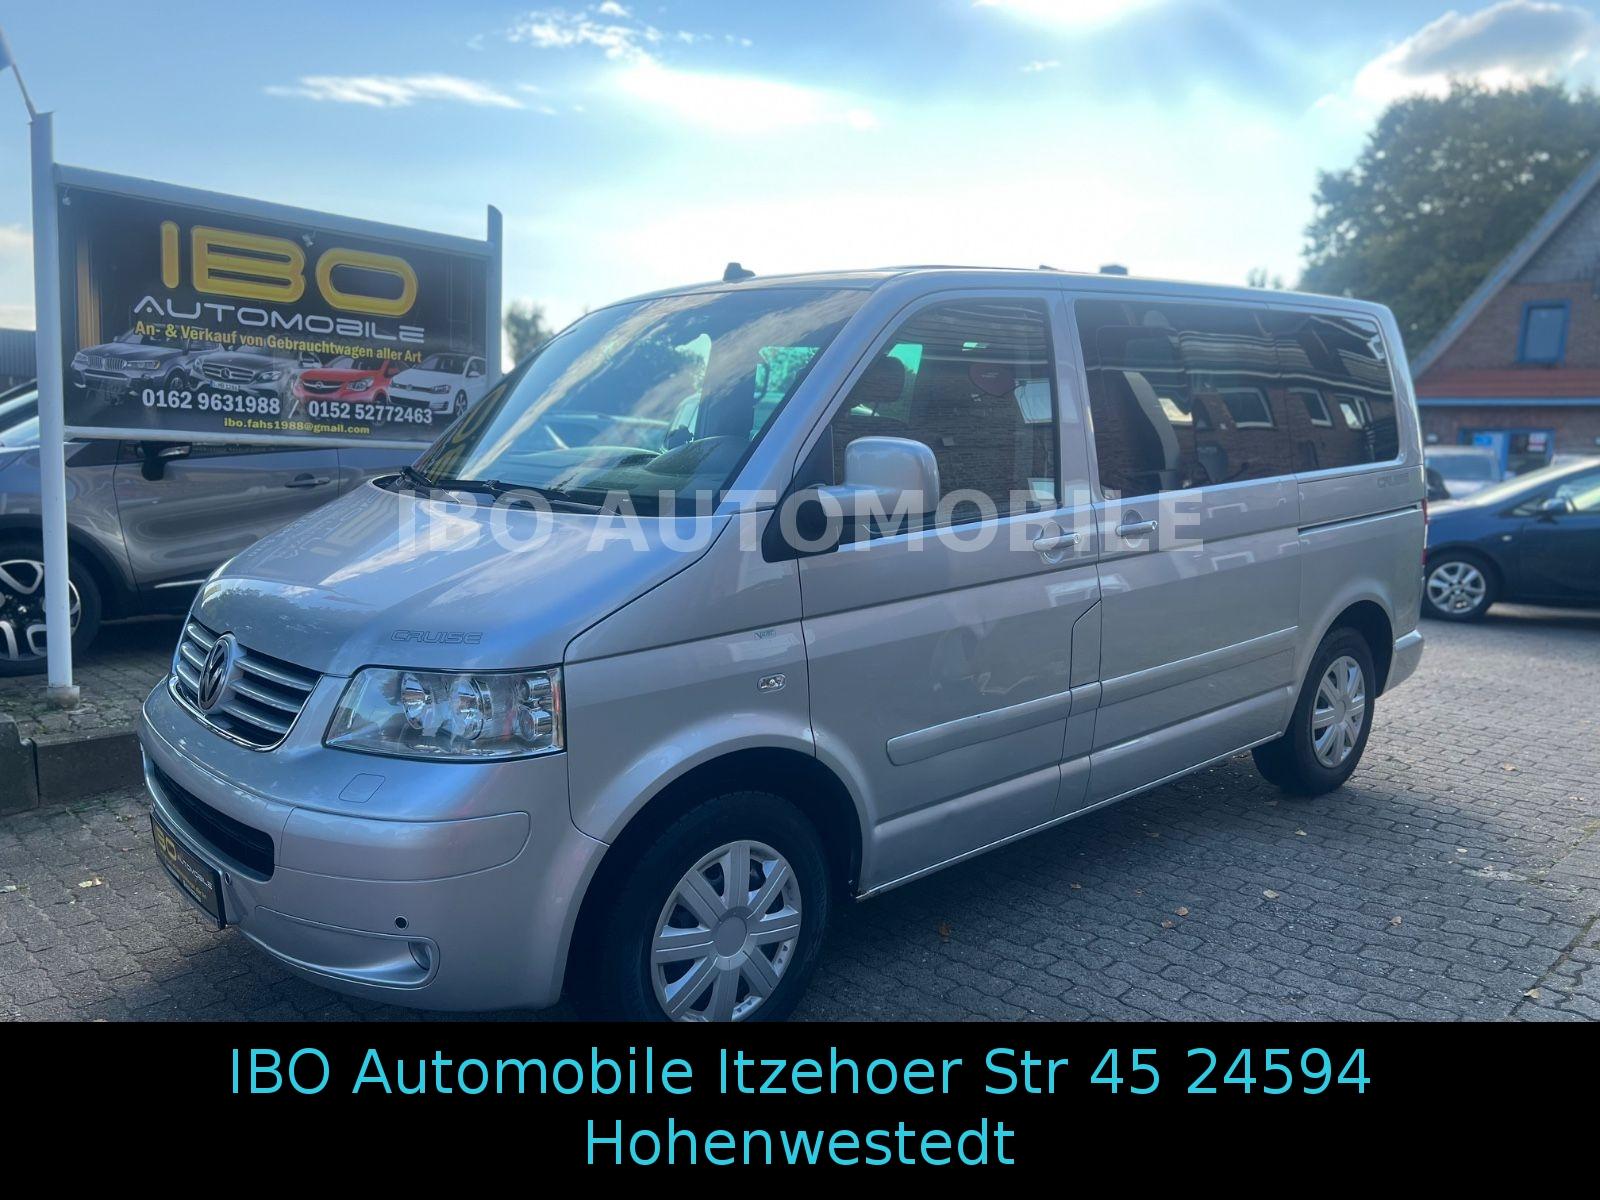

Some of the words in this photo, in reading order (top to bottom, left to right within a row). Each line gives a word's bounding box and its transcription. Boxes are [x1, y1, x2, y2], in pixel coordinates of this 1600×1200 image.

[160, 220, 418, 318] IBO
[133, 295, 425, 344] AUTOMOBILE
[134, 320, 160, 336] An-
[165, 323, 178, 338] &
[180, 324, 238, 345] Verkauf
[240, 334, 263, 347] von
[267, 334, 374, 359] Gebrauchtwagen
[376, 347, 403, 361] aller
[404, 350, 422, 363] Art
[142, 388, 193, 409] 0162
[197, 392, 280, 415] 9631988
[288, 399, 299, 419] /
[308, 400, 351, 419] 0152
[355, 403, 432, 424] 52772463
[223, 417, 370, 434] ibo.fahs1988@gmail.com
[391, 629, 483, 645] CRUISE
